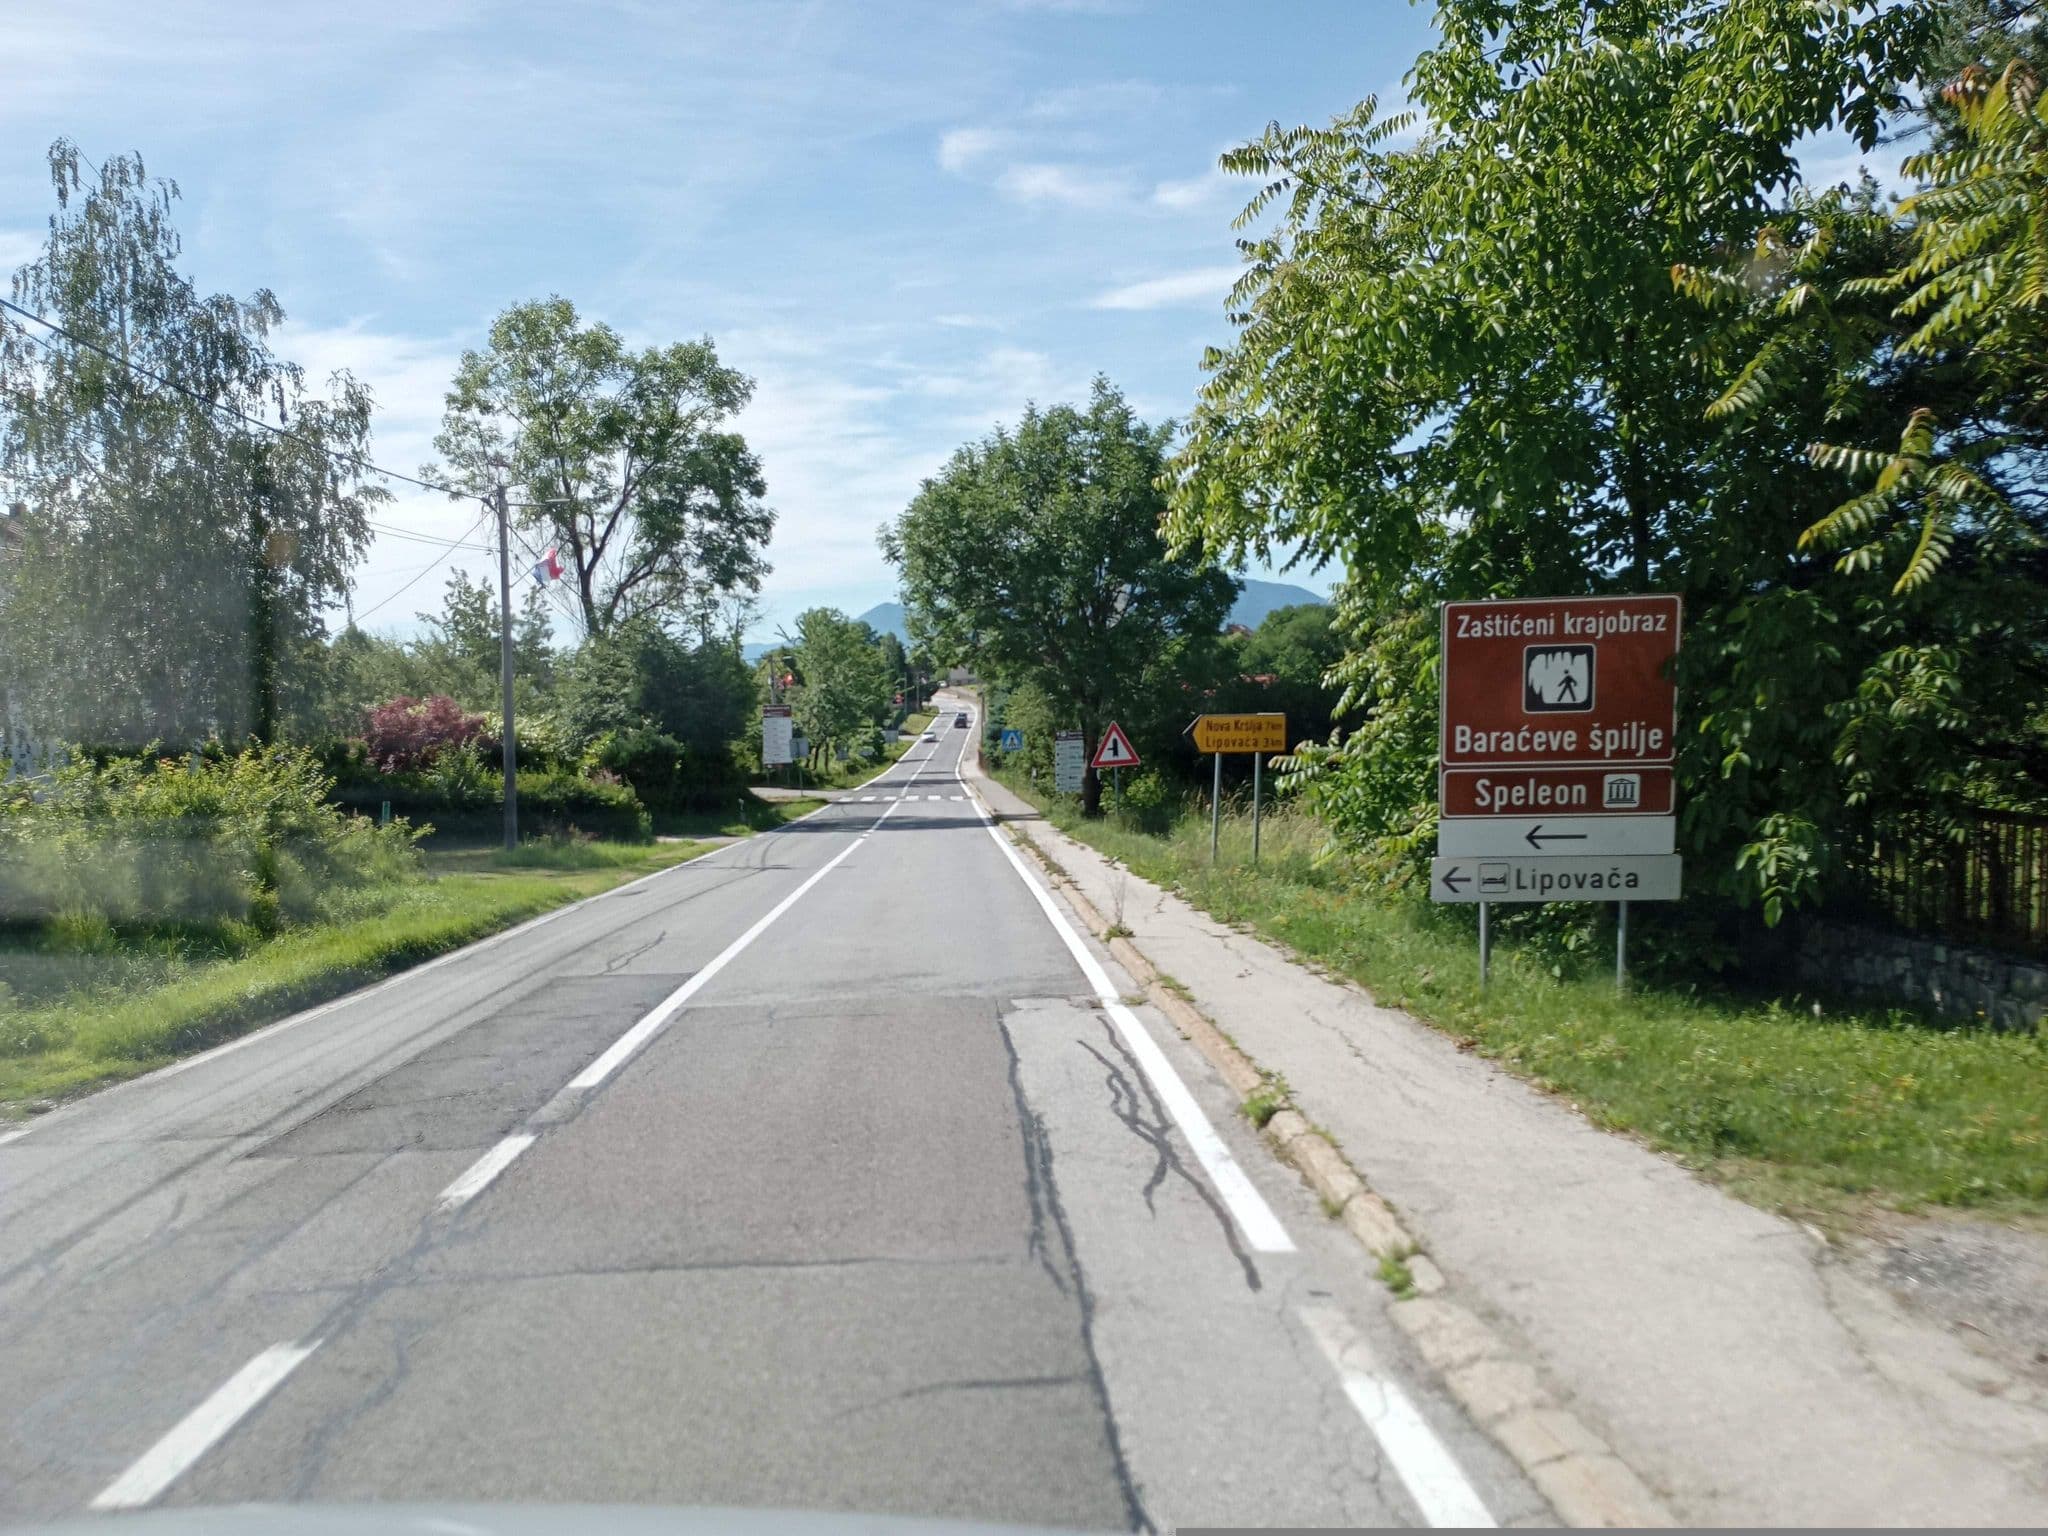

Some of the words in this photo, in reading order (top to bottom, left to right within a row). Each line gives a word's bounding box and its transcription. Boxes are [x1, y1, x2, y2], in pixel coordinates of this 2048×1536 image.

[1456, 613, 1554, 638] Zaštićeni
[1564, 611, 1668, 639] krajobraz
[1206, 720, 1230, 732] Nova
[1455, 724, 1577, 753] Baraćeve
[1589, 722, 1663, 758] špilje
[1475, 778, 1587, 812] Speleon
[1515, 867, 1639, 895] Lipovača
